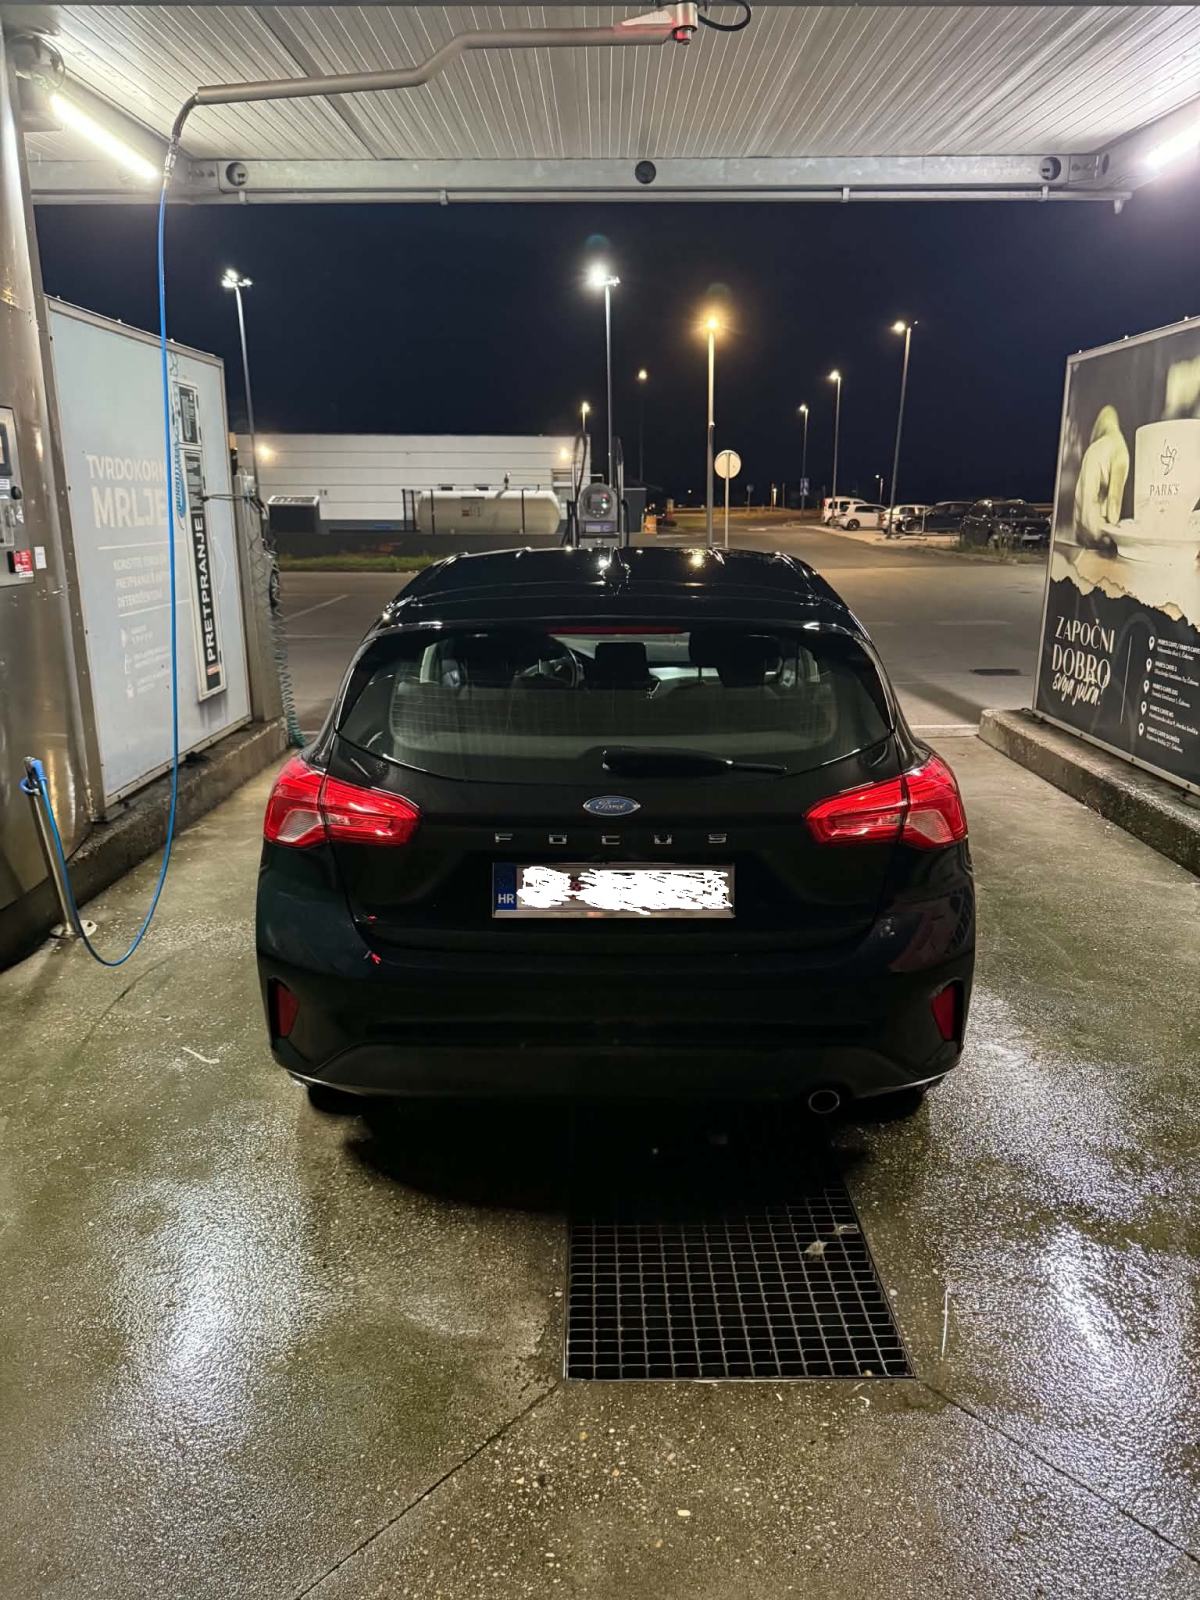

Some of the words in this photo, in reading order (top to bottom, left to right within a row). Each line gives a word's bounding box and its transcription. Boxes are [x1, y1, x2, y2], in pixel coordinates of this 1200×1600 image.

[91, 486, 170, 528] MRLJE
[194, 517, 217, 662] PRETPRANJE
[1055, 615, 1116, 654] ZAPOČNI
[1052, 644, 1111, 689] DOBRO
[595, 799, 627, 810] Ford
[494, 833, 728, 846] FOCUS
[497, 893, 515, 905] HR
